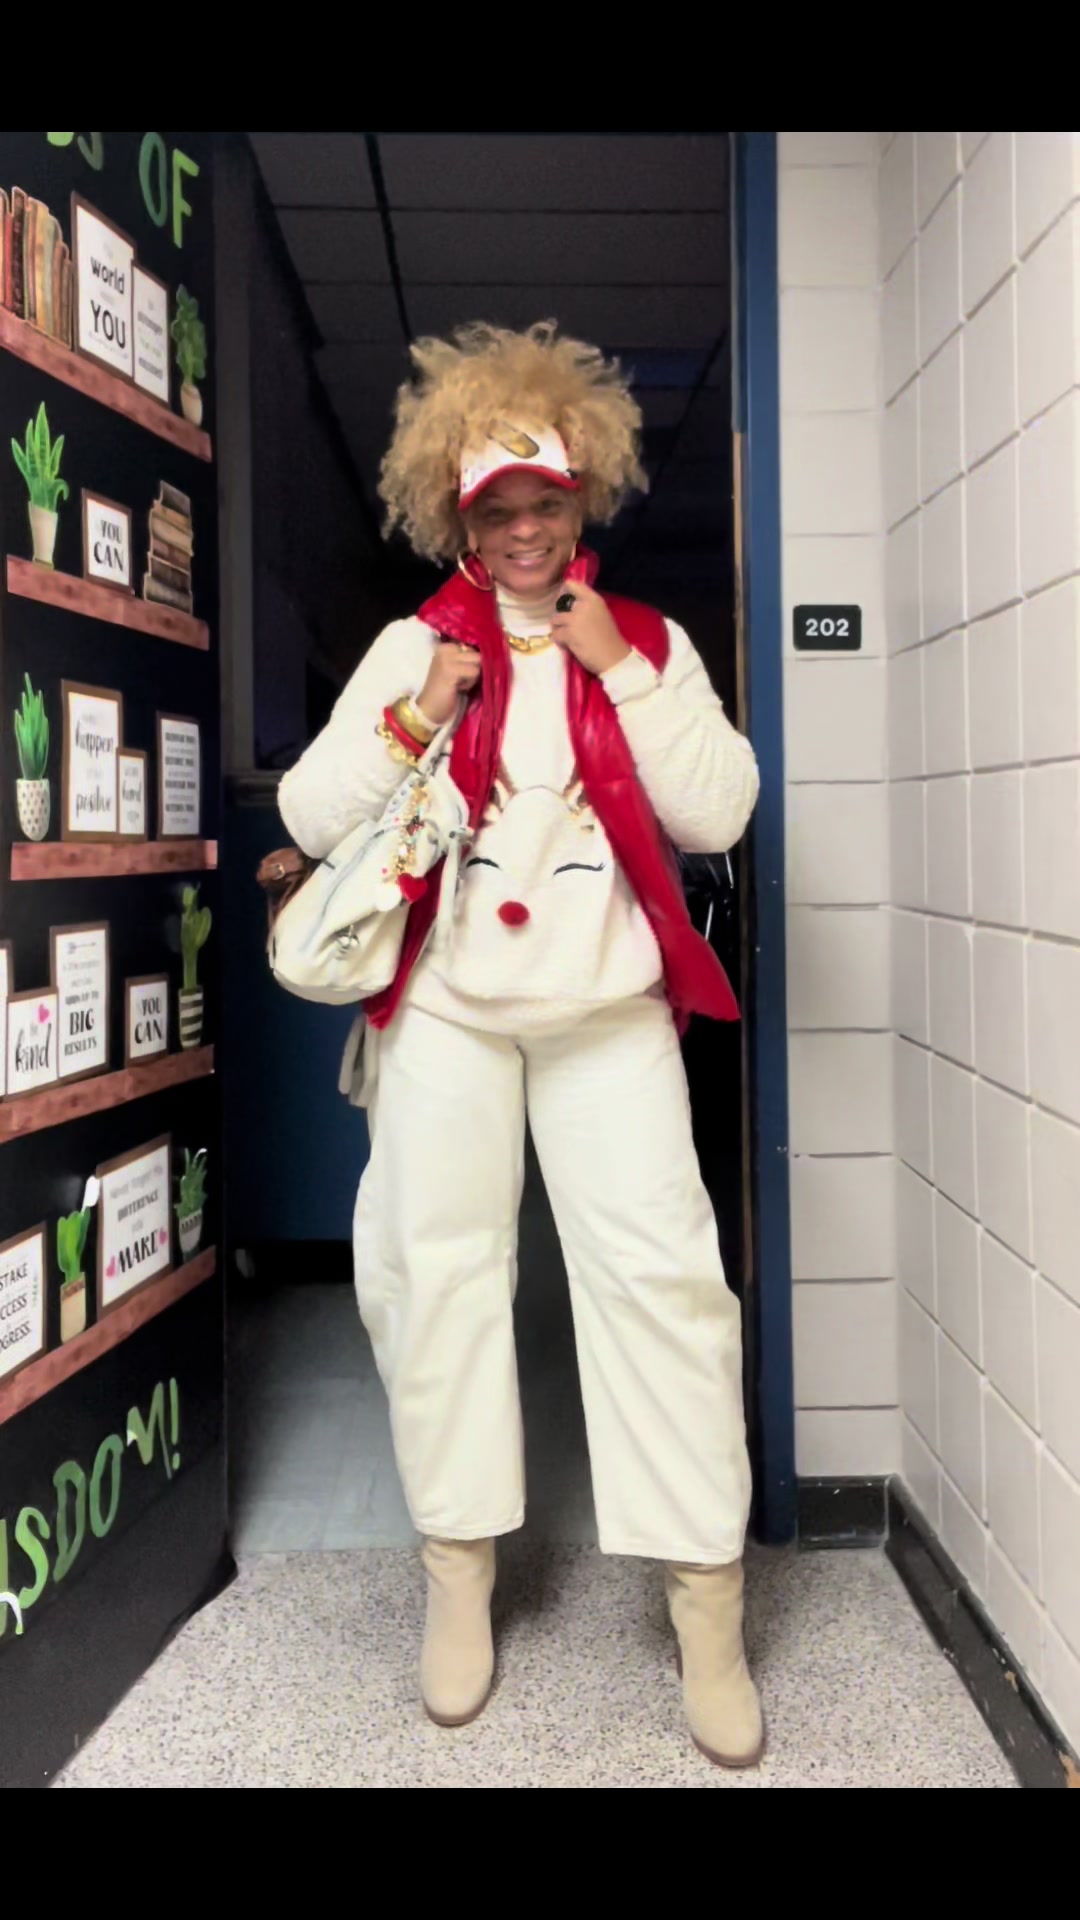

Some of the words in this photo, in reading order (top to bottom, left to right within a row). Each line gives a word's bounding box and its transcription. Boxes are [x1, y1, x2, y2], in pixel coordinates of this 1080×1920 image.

[139, 132, 199, 249] OF
[90, 256, 125, 295] world
[90, 299, 126, 349] YOU
[100, 519, 122, 544] YOU
[93, 541, 124, 572] CAN
[805, 618, 849, 637] 202
[141, 997, 161, 1017] YOU
[69, 1008, 95, 1036] BIG
[134, 1020, 163, 1044] CAN
[15, 1022, 52, 1073] kind
[64, 1036, 98, 1056] RESULTS
[118, 1229, 158, 1273] MAKE
